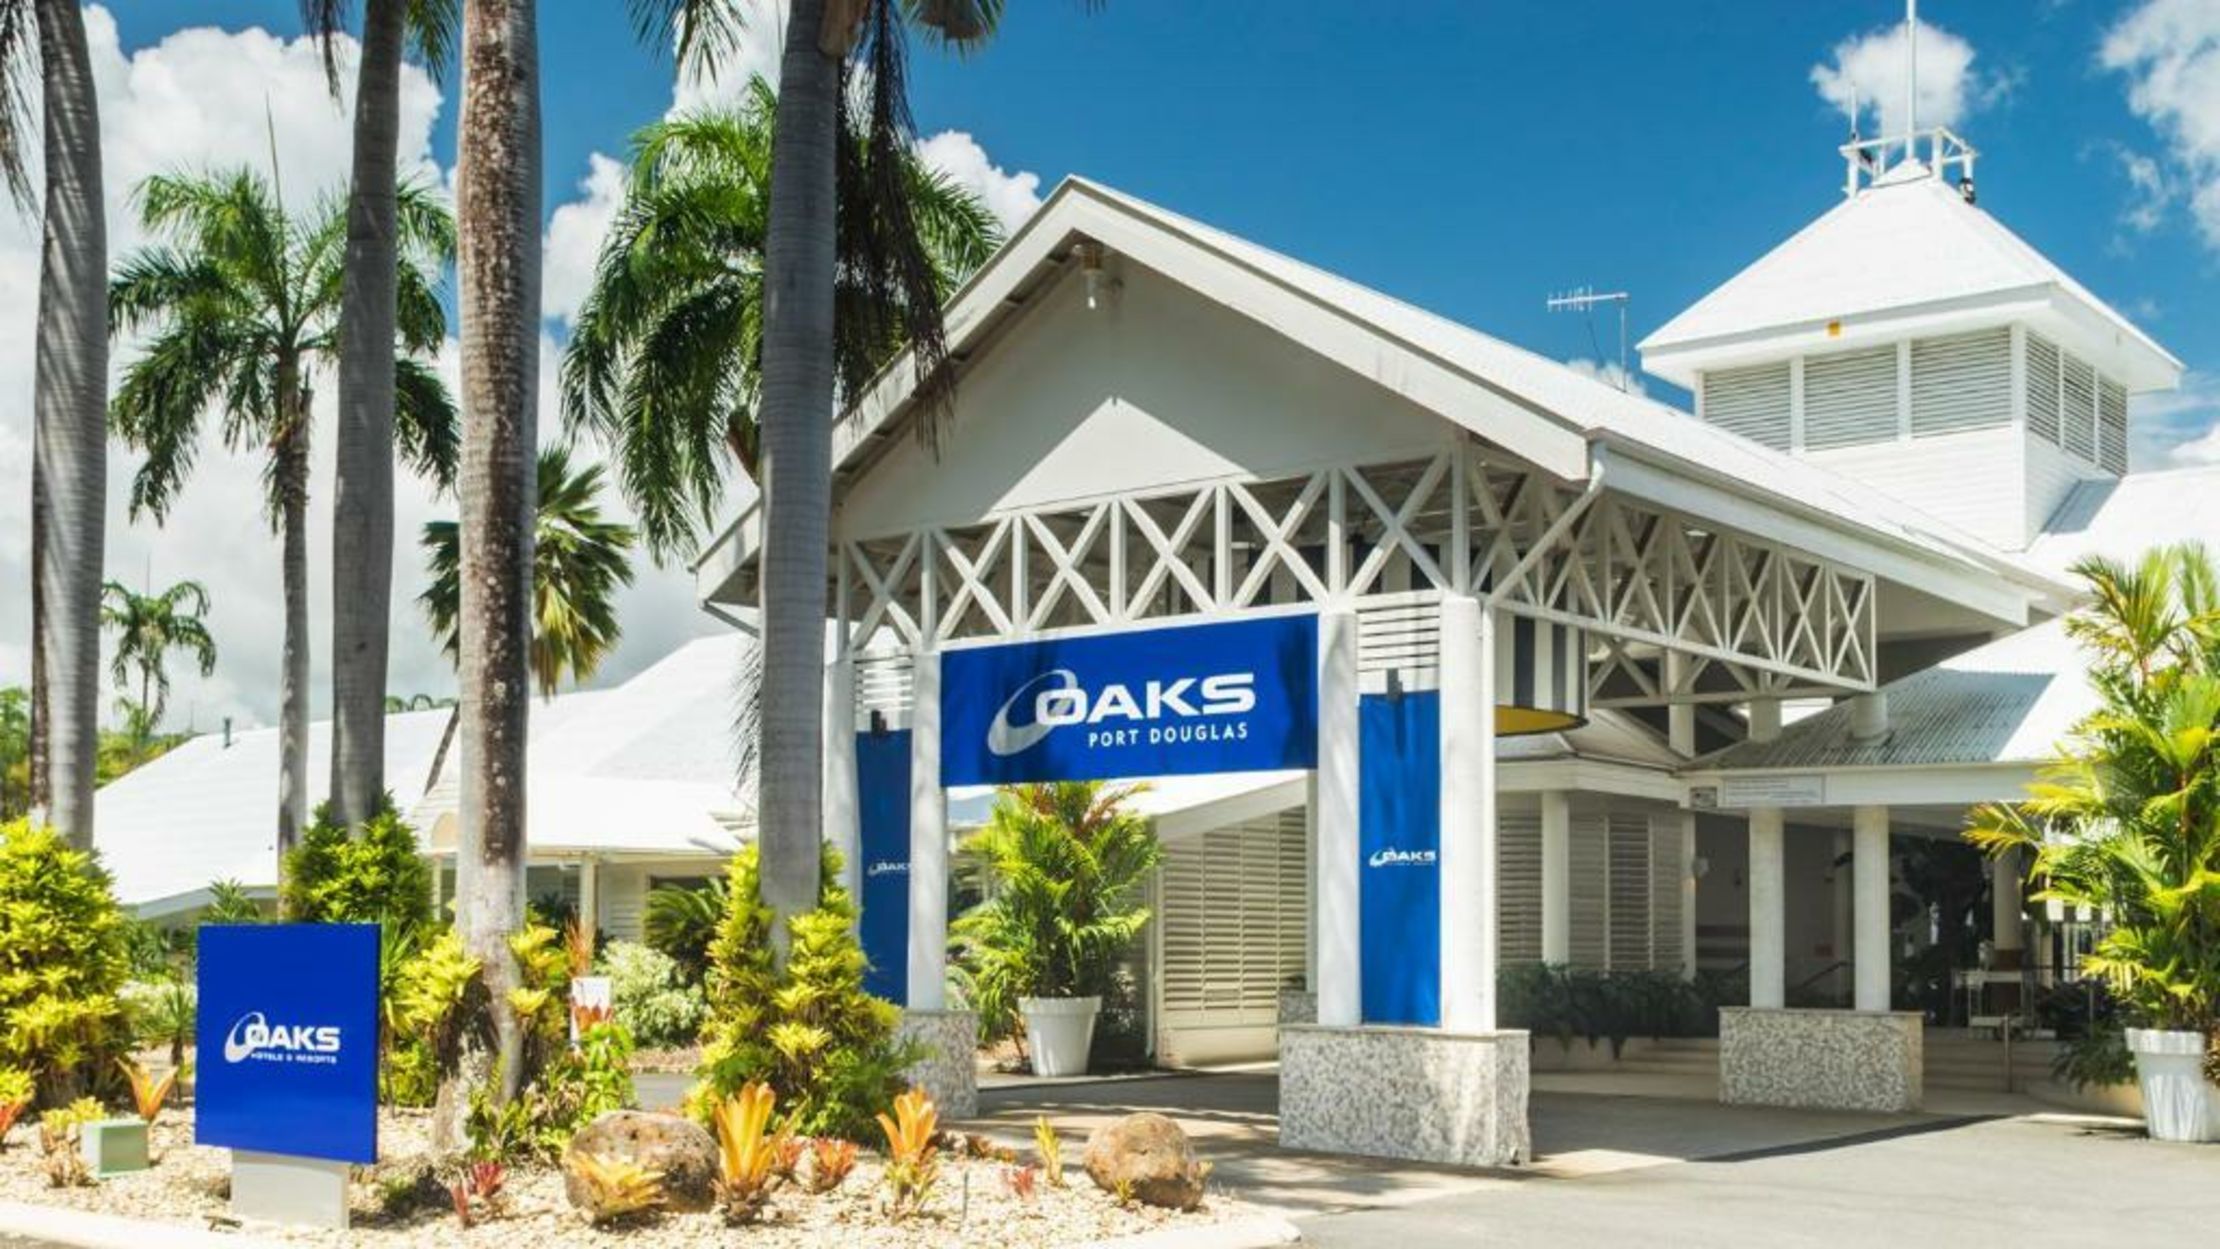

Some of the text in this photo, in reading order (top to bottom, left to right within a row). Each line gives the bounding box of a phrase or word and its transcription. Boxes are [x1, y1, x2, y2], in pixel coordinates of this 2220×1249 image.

[1035, 672, 1256, 727] OAKS
[1088, 721, 1248, 748] PORT DOUGLAS
[877, 862, 911, 871] OAK
[1382, 849, 1436, 861] OAKS
[244, 1023, 341, 1052] OAKS
